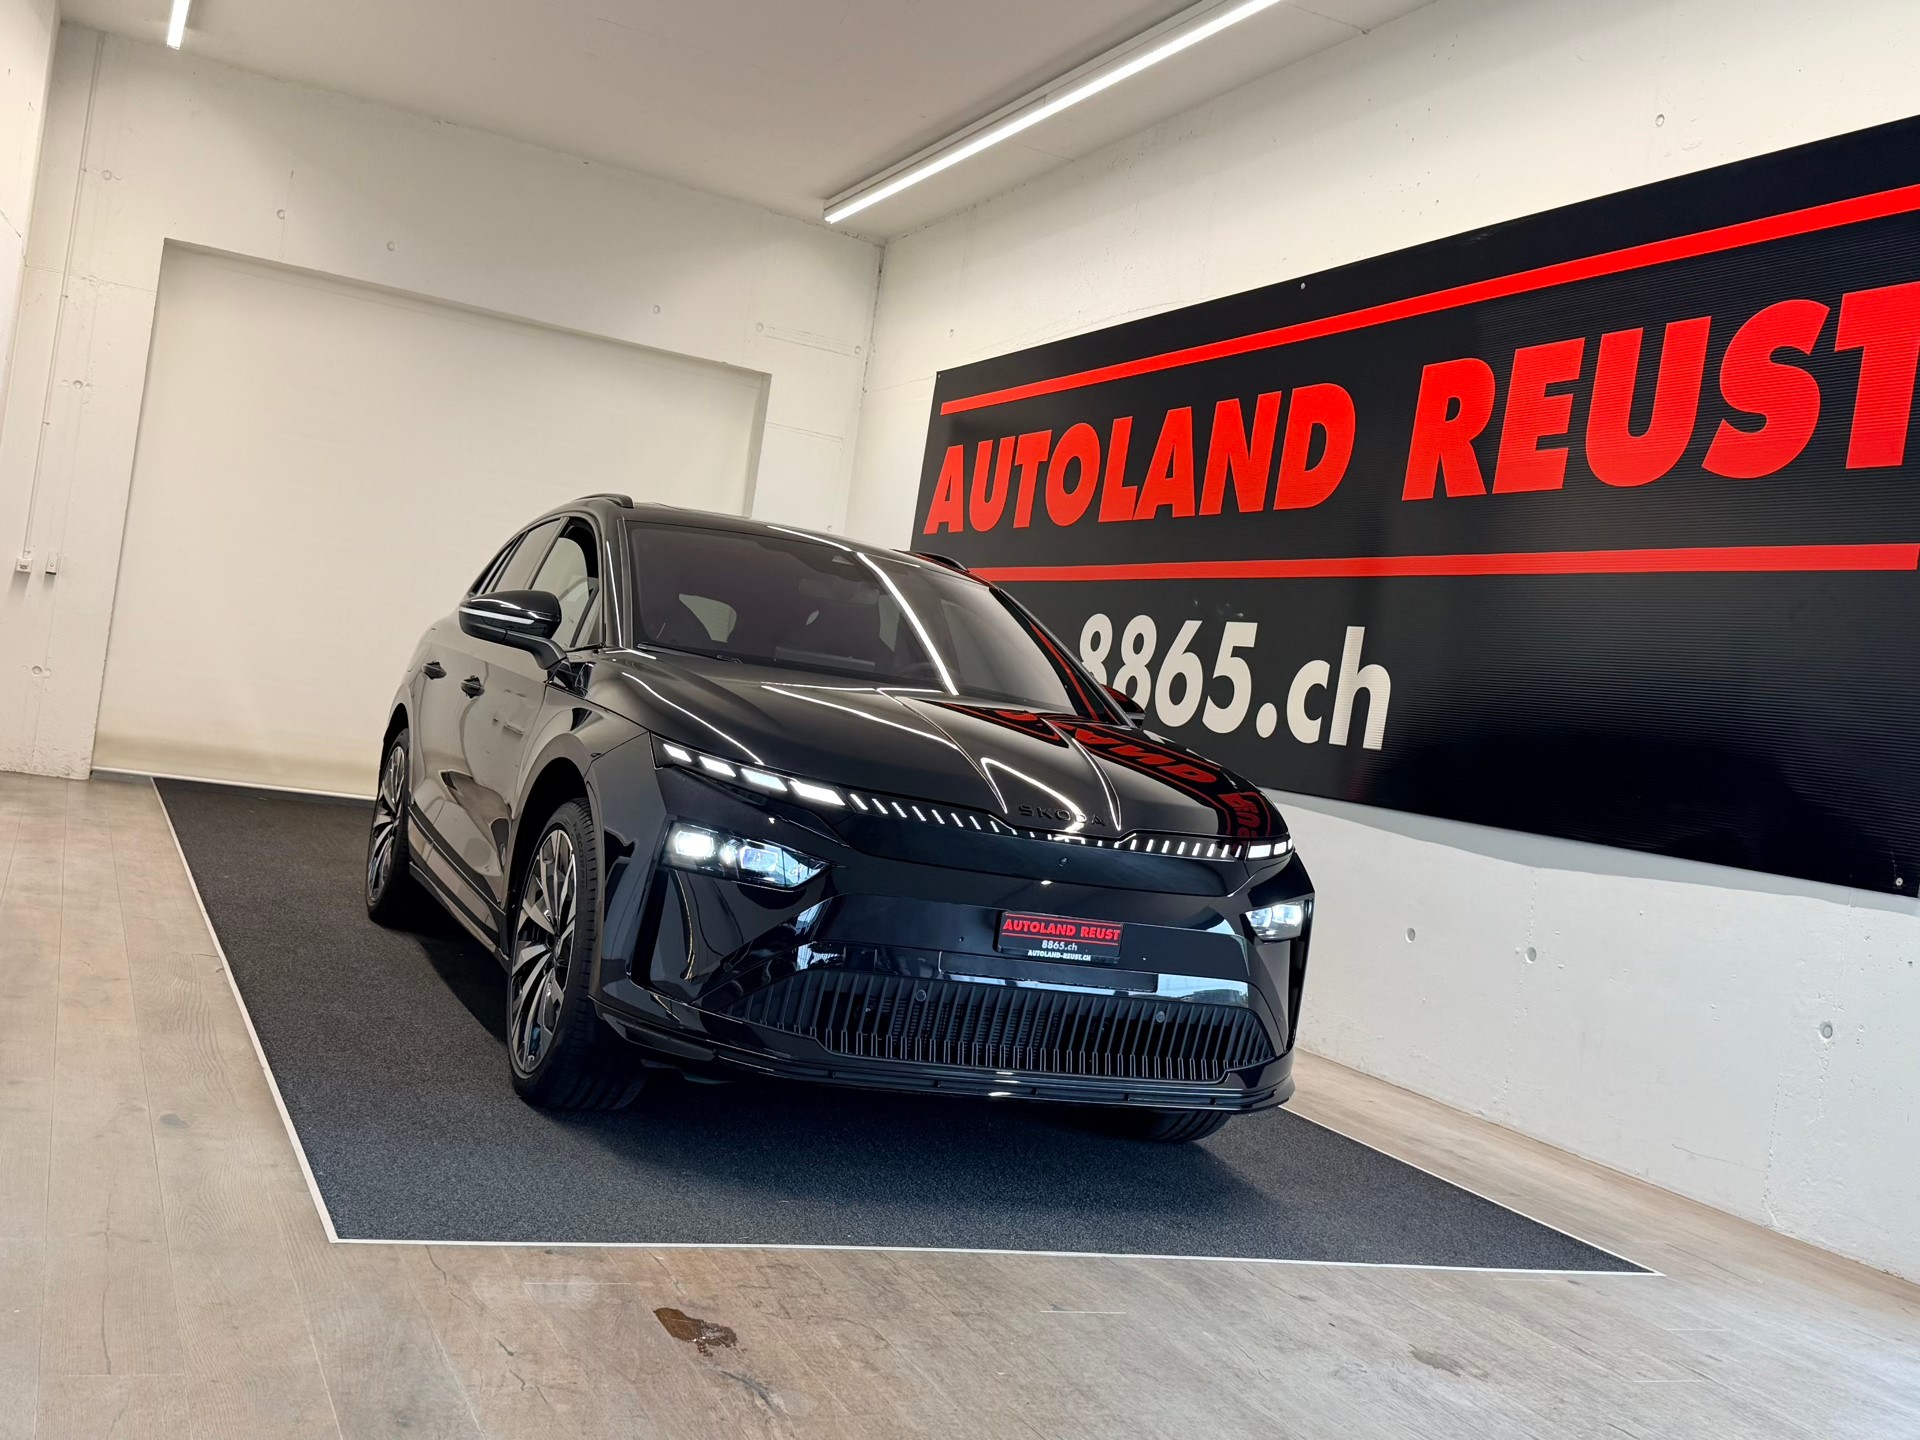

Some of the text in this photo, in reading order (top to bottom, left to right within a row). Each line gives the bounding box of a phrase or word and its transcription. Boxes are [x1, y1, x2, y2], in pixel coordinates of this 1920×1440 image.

[924, 280, 1920, 535] AUTOLAND REUST
[1079, 613, 1391, 750] 8865.ch
[1003, 919, 1120, 940] AUTOLAND REUST
[1027, 949, 1092, 961] AUTOLAND-REUST.CH
[1041, 939, 1078, 951] 8865.ch
